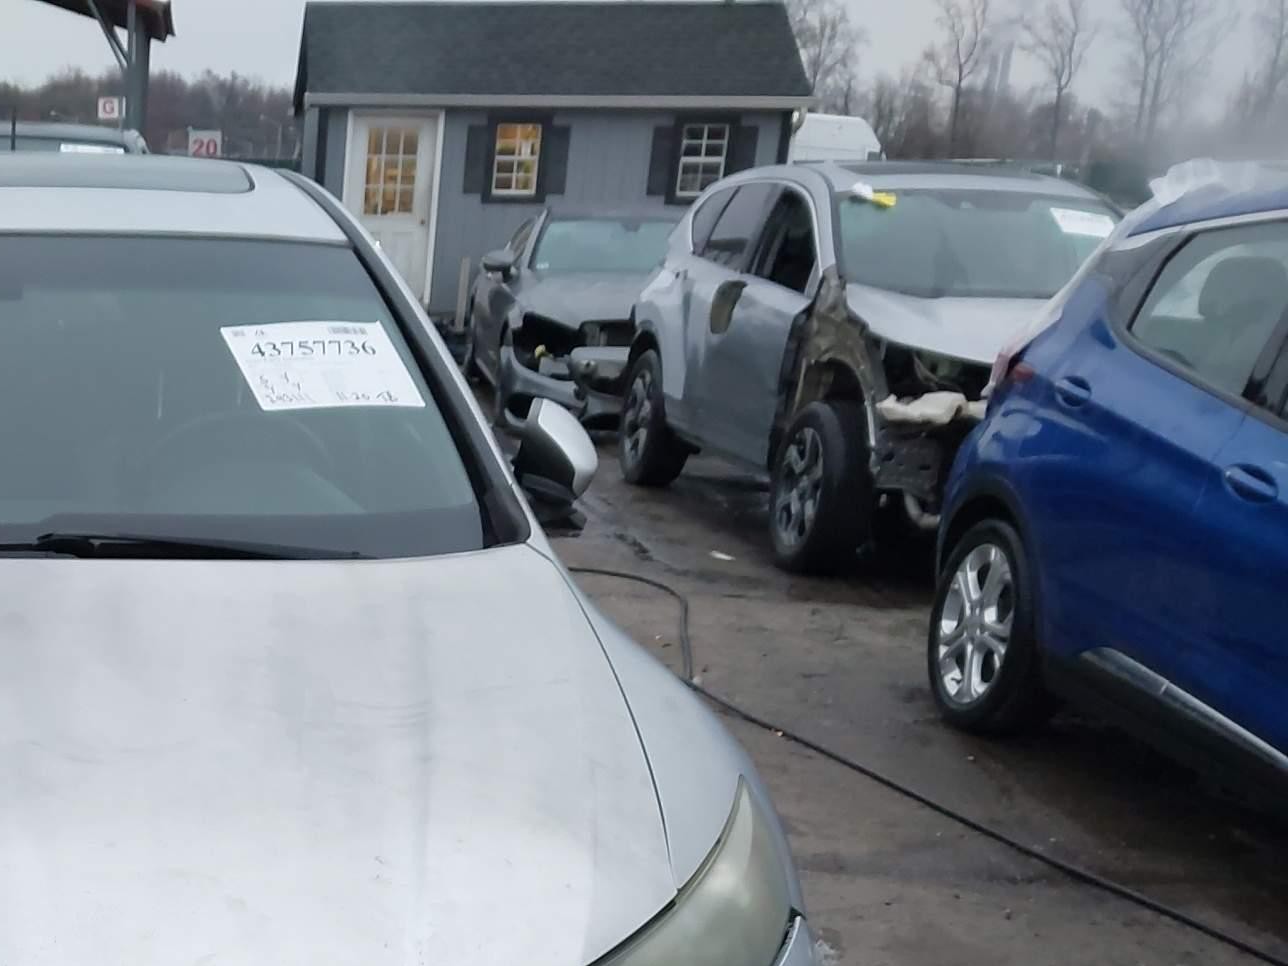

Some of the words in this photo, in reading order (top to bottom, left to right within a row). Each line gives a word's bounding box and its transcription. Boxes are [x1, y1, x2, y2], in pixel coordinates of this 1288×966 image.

[102, 99, 116, 115] G
[192, 137, 218, 157] 20
[251, 340, 376, 358] 43757736
